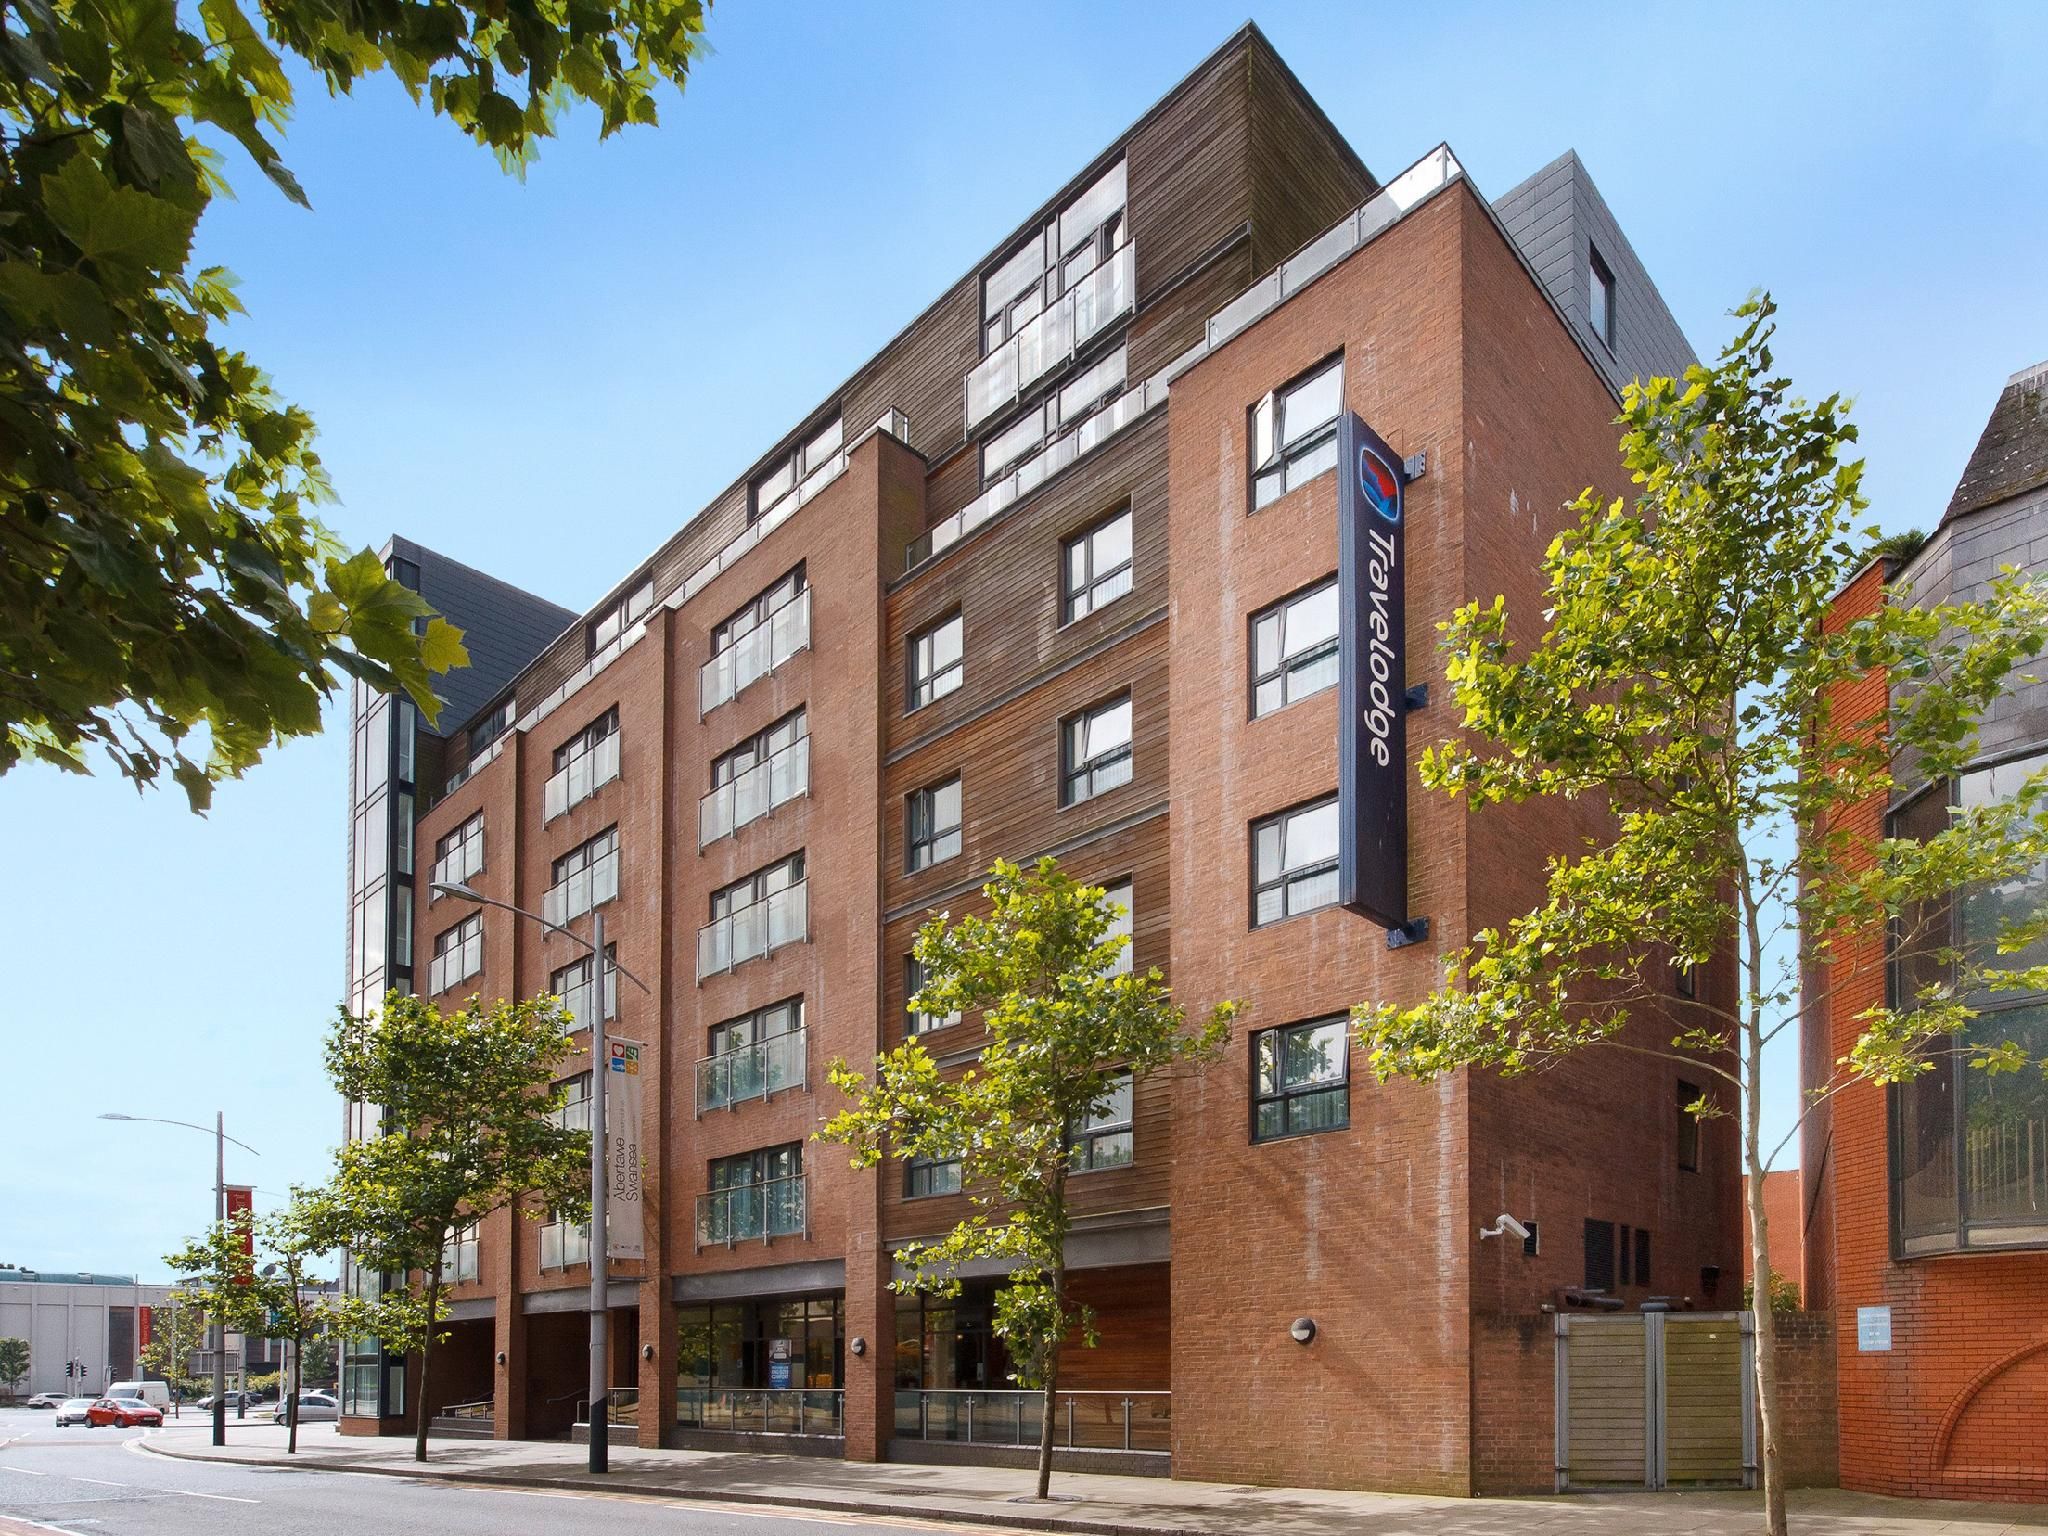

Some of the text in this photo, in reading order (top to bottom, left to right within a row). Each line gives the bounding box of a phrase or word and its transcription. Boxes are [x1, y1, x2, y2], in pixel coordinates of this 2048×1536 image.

[1364, 529, 1395, 767] Travelodge
[613, 1137, 626, 1201] Abertawe
[626, 1143, 638, 1201] Swansea
